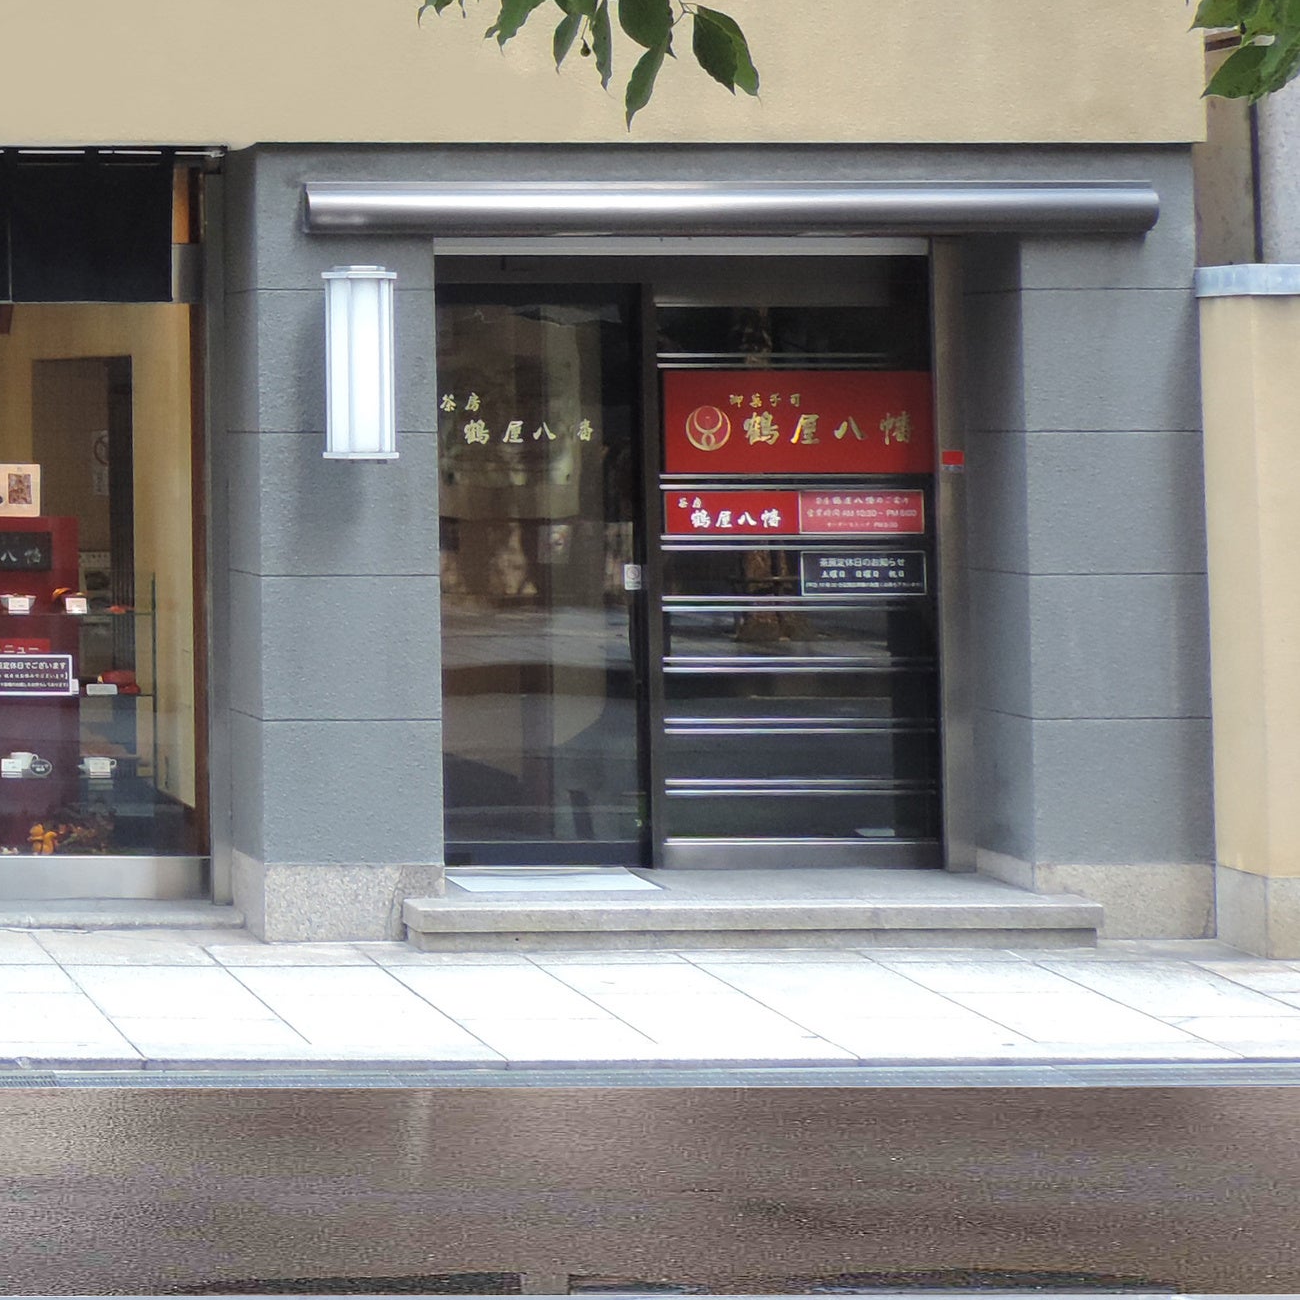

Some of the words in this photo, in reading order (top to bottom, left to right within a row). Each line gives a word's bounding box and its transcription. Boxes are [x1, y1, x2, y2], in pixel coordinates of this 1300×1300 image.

[743, 411, 912, 445] 鶴屋八幡
[690, 509, 781, 528] 鶴屋八幡
